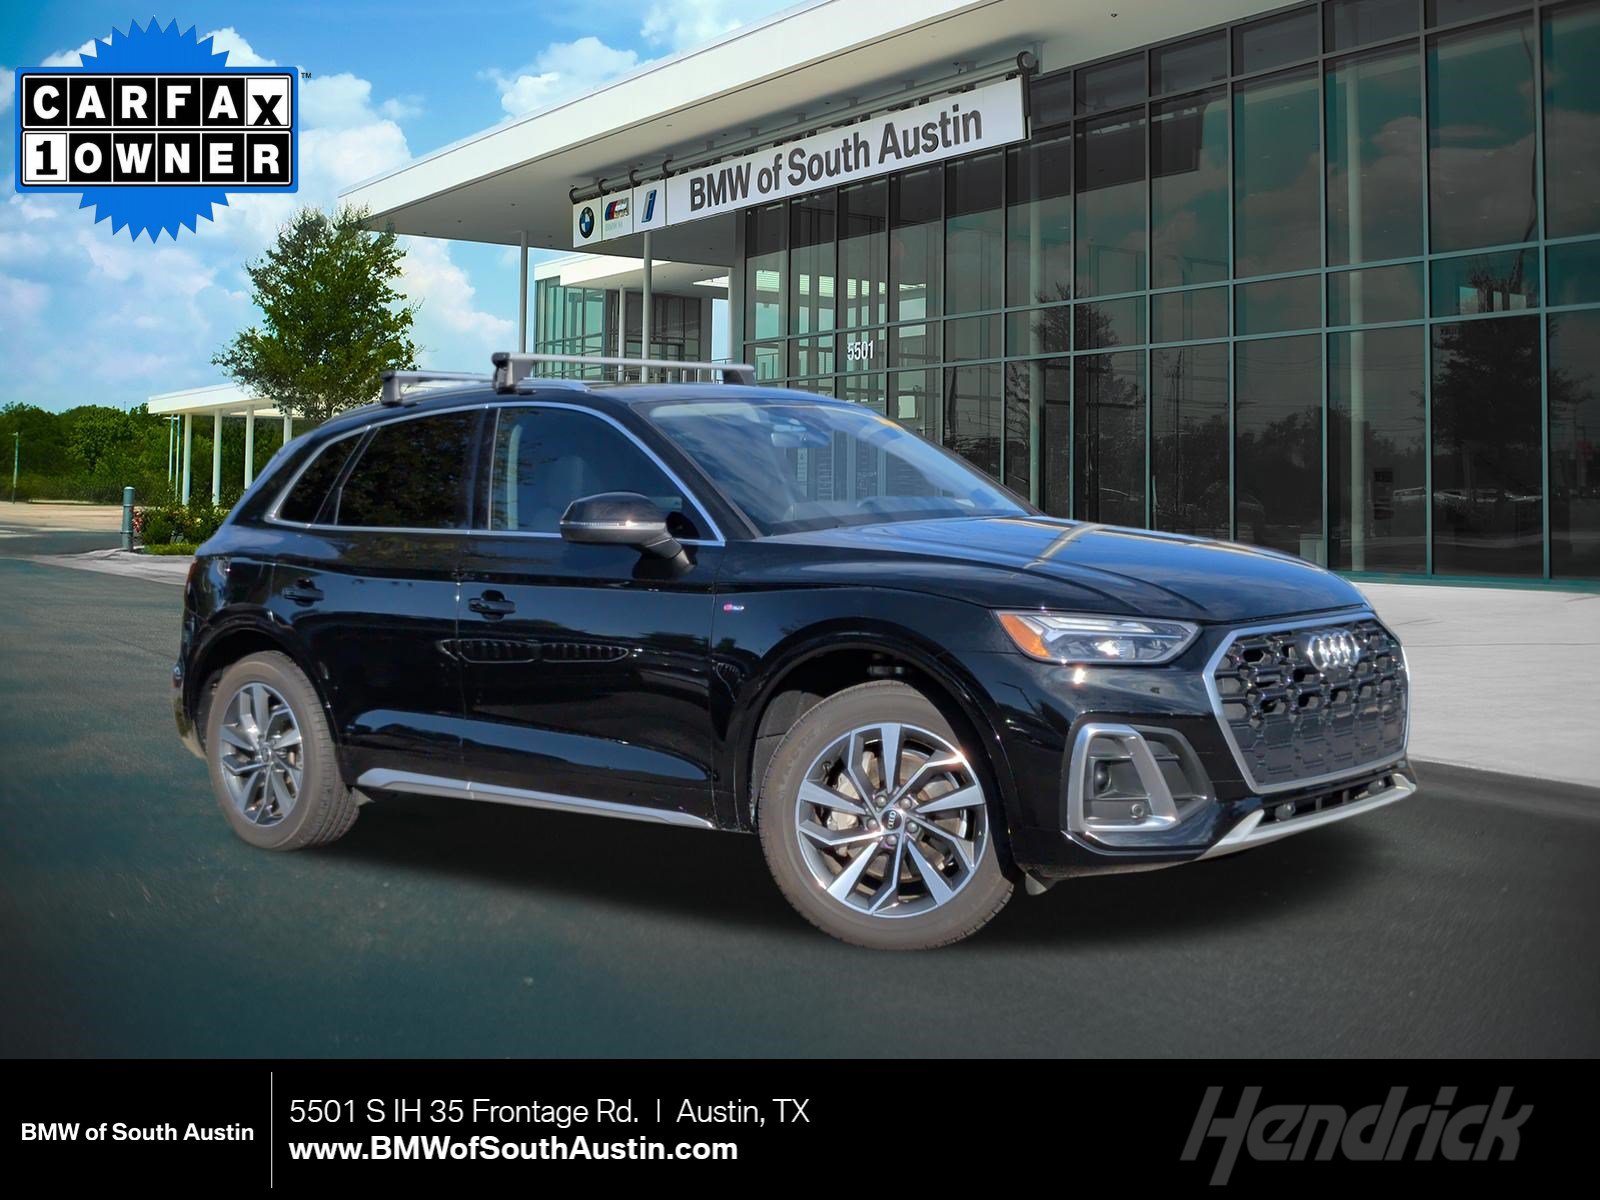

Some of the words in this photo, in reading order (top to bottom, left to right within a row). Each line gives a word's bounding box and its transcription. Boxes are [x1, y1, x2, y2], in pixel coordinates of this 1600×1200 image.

[689, 162, 752, 212] BMW
[757, 153, 783, 194] of
[787, 131, 870, 187] South
[878, 103, 983, 164] Austin
[847, 339, 874, 361] 5501
